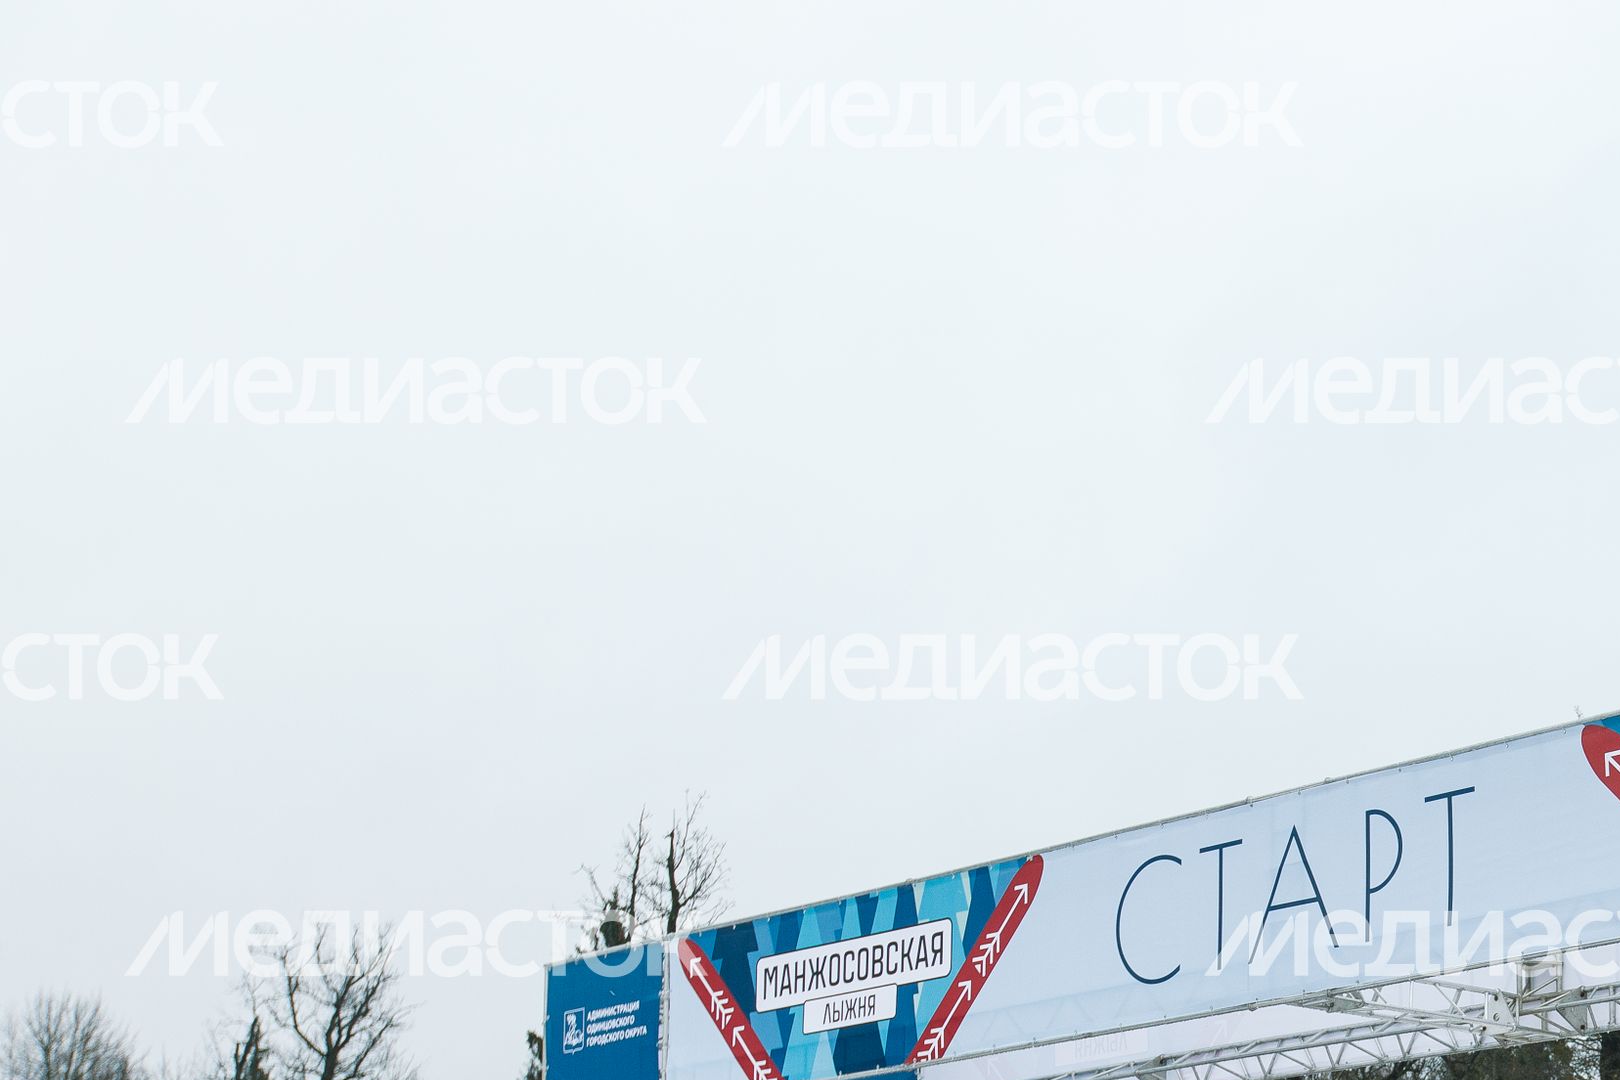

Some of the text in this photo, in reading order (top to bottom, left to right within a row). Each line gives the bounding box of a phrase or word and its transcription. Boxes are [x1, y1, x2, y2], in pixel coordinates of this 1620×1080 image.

[1115, 786, 1476, 985] СТАРТ
[762, 930, 945, 1001] МАНЖОСОВСКАЯ
[821, 994, 877, 1026] ЛЫЖНЯ
[586, 1025, 648, 1047] ГОРОДСКОГО ОКРУГА
